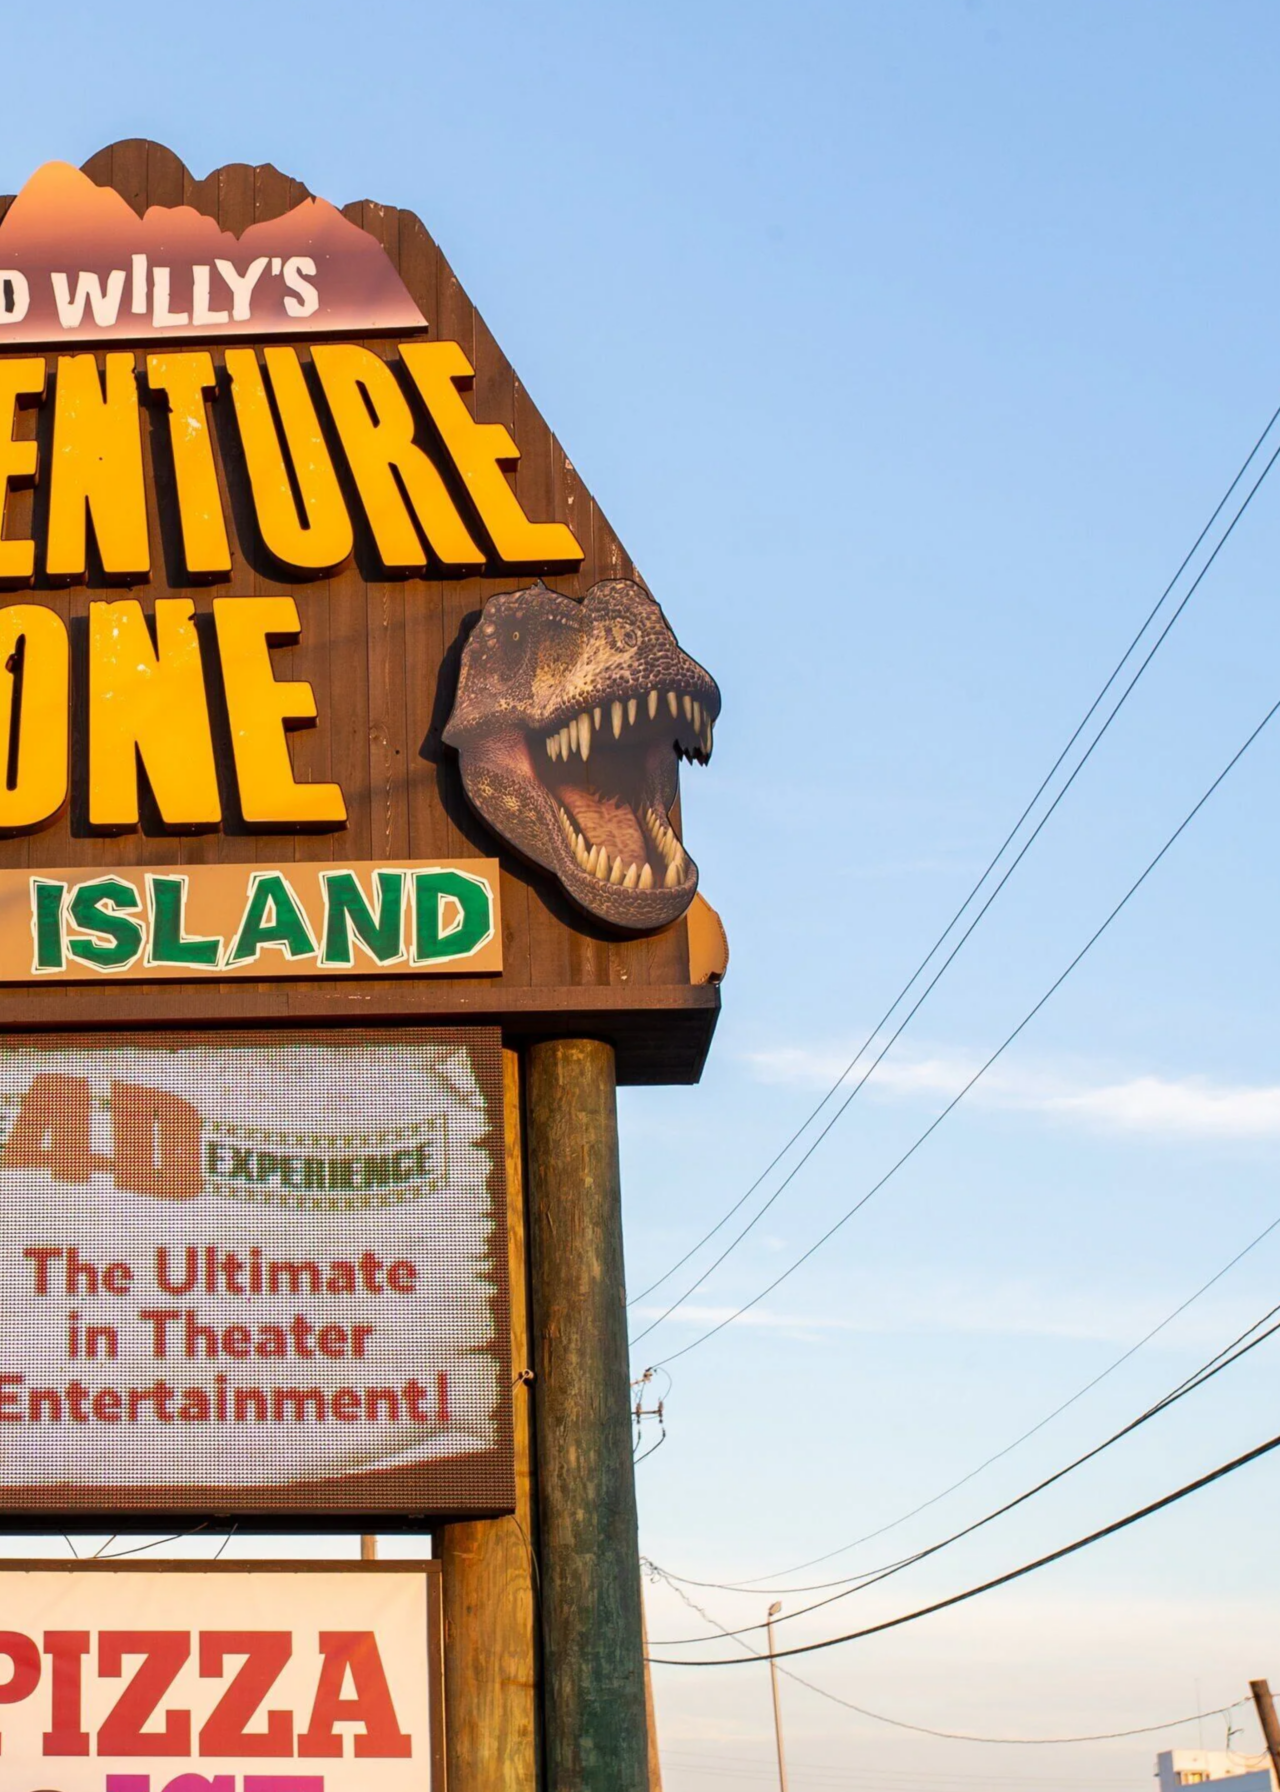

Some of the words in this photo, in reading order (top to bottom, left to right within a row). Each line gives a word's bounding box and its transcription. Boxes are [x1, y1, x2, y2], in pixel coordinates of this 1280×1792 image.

[51, 254, 319, 329] WILLY'S
[30, 868, 495, 973] ISLAND
[0, 1072, 203, 1200] 4D
[205, 1139, 432, 1192] EXPERIENCE
[23, 1246, 133, 1296] The
[155, 1246, 417, 1296] Ultimate
[68, 1310, 118, 1360] in
[140, 1309, 374, 1360] Theater
